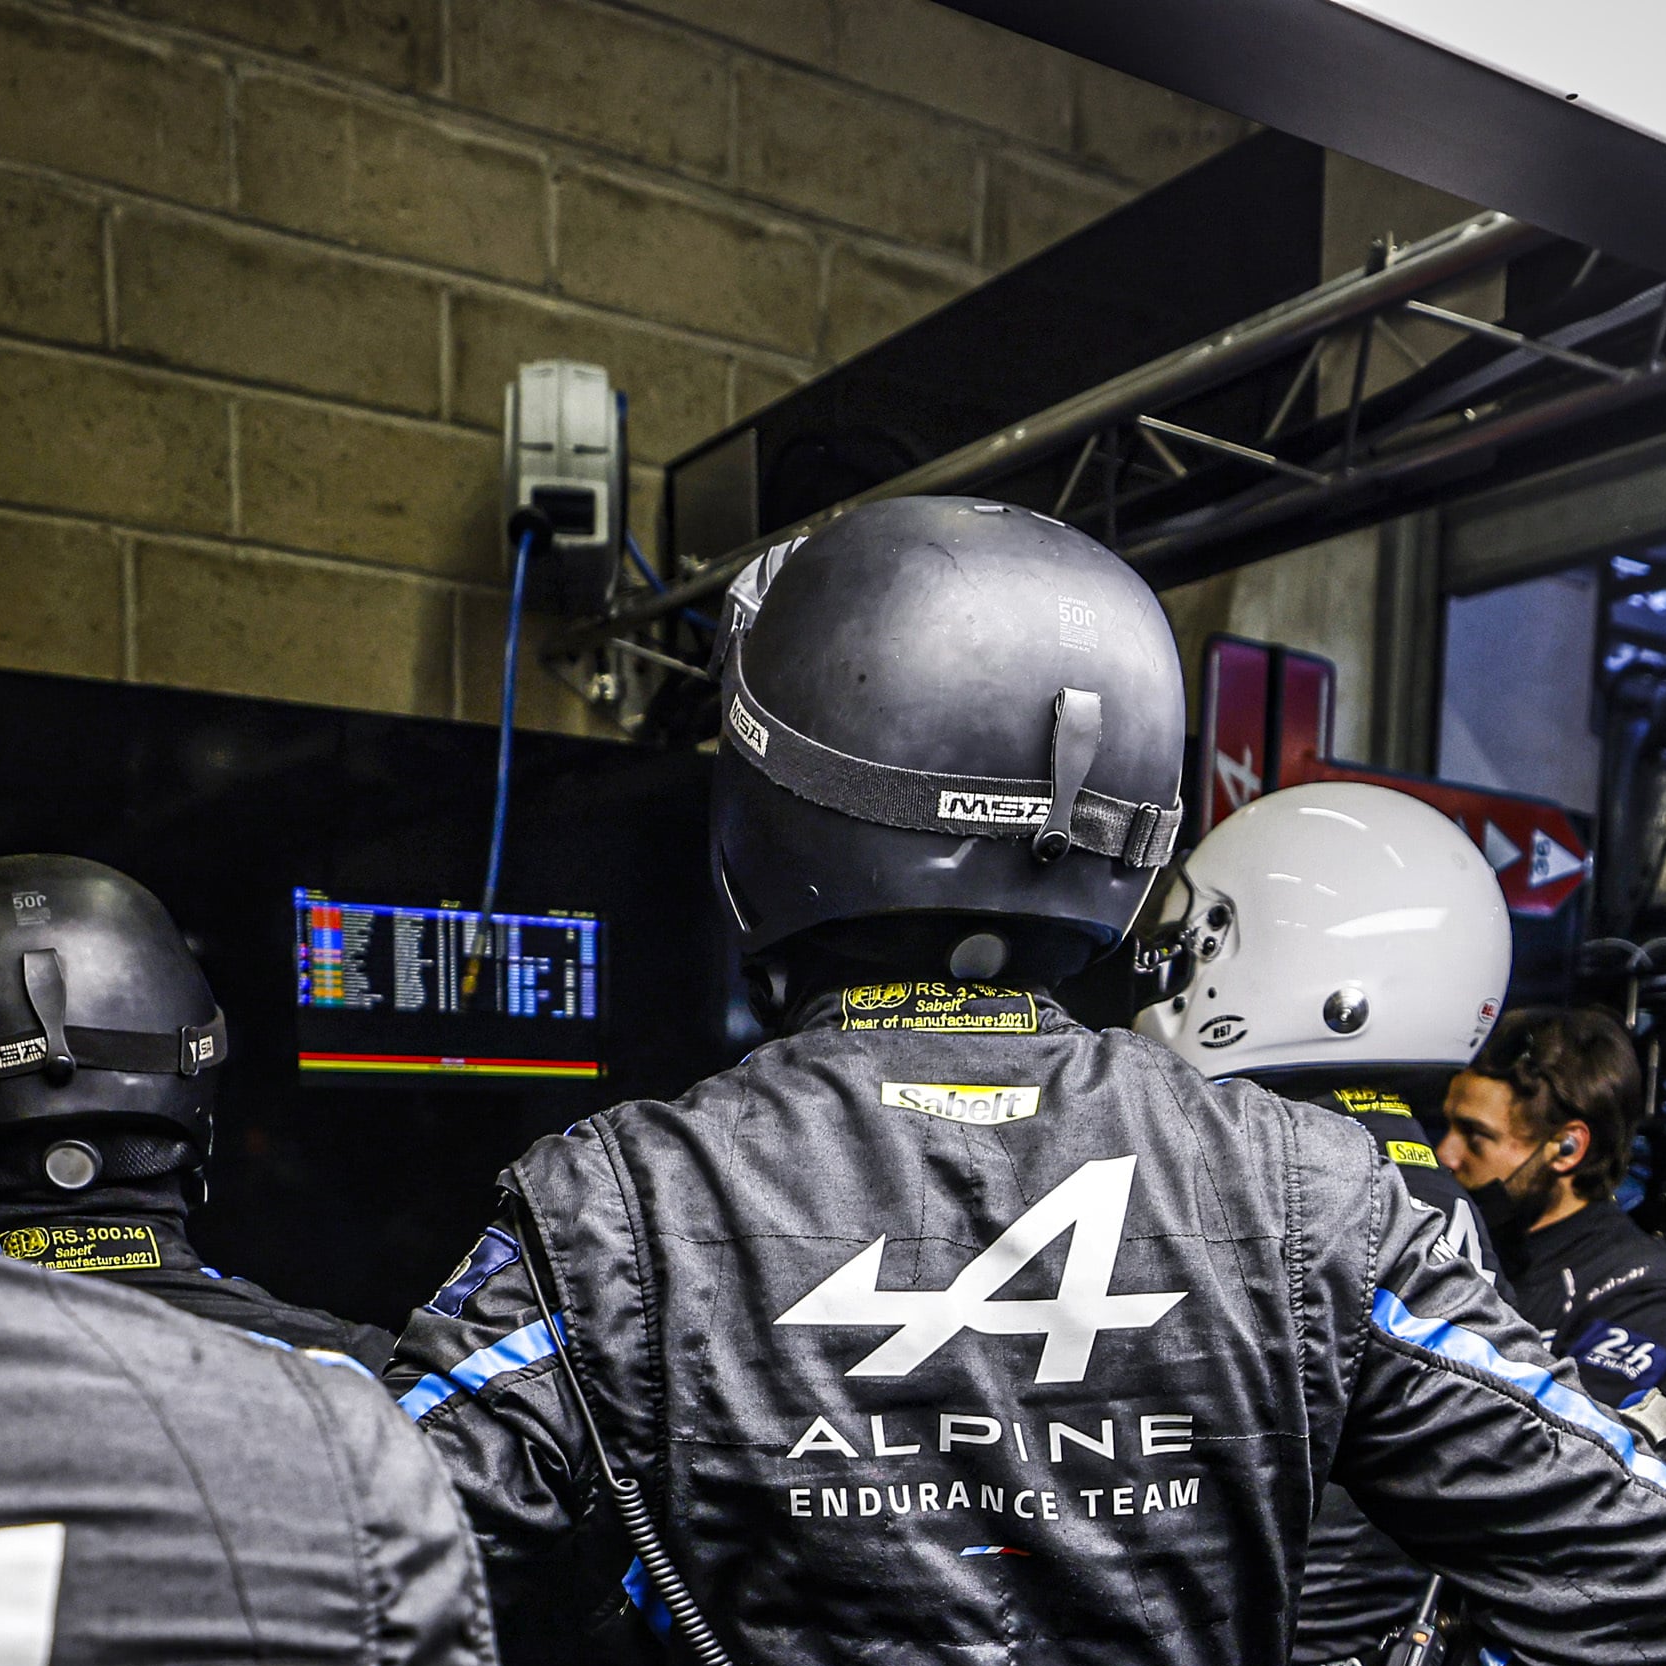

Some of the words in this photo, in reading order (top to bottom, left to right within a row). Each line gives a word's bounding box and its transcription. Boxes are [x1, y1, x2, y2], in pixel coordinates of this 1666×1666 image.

[949, 797, 1051, 819] MSA
[851, 1017, 878, 1030] Year
[885, 1014, 899, 1029] of
[898, 1087, 1022, 1121] Sabelt
[786, 1413, 1194, 1463] ALPINE
[789, 1480, 1060, 1520] ENDURANCE
[1080, 1477, 1200, 1518] TEAM
